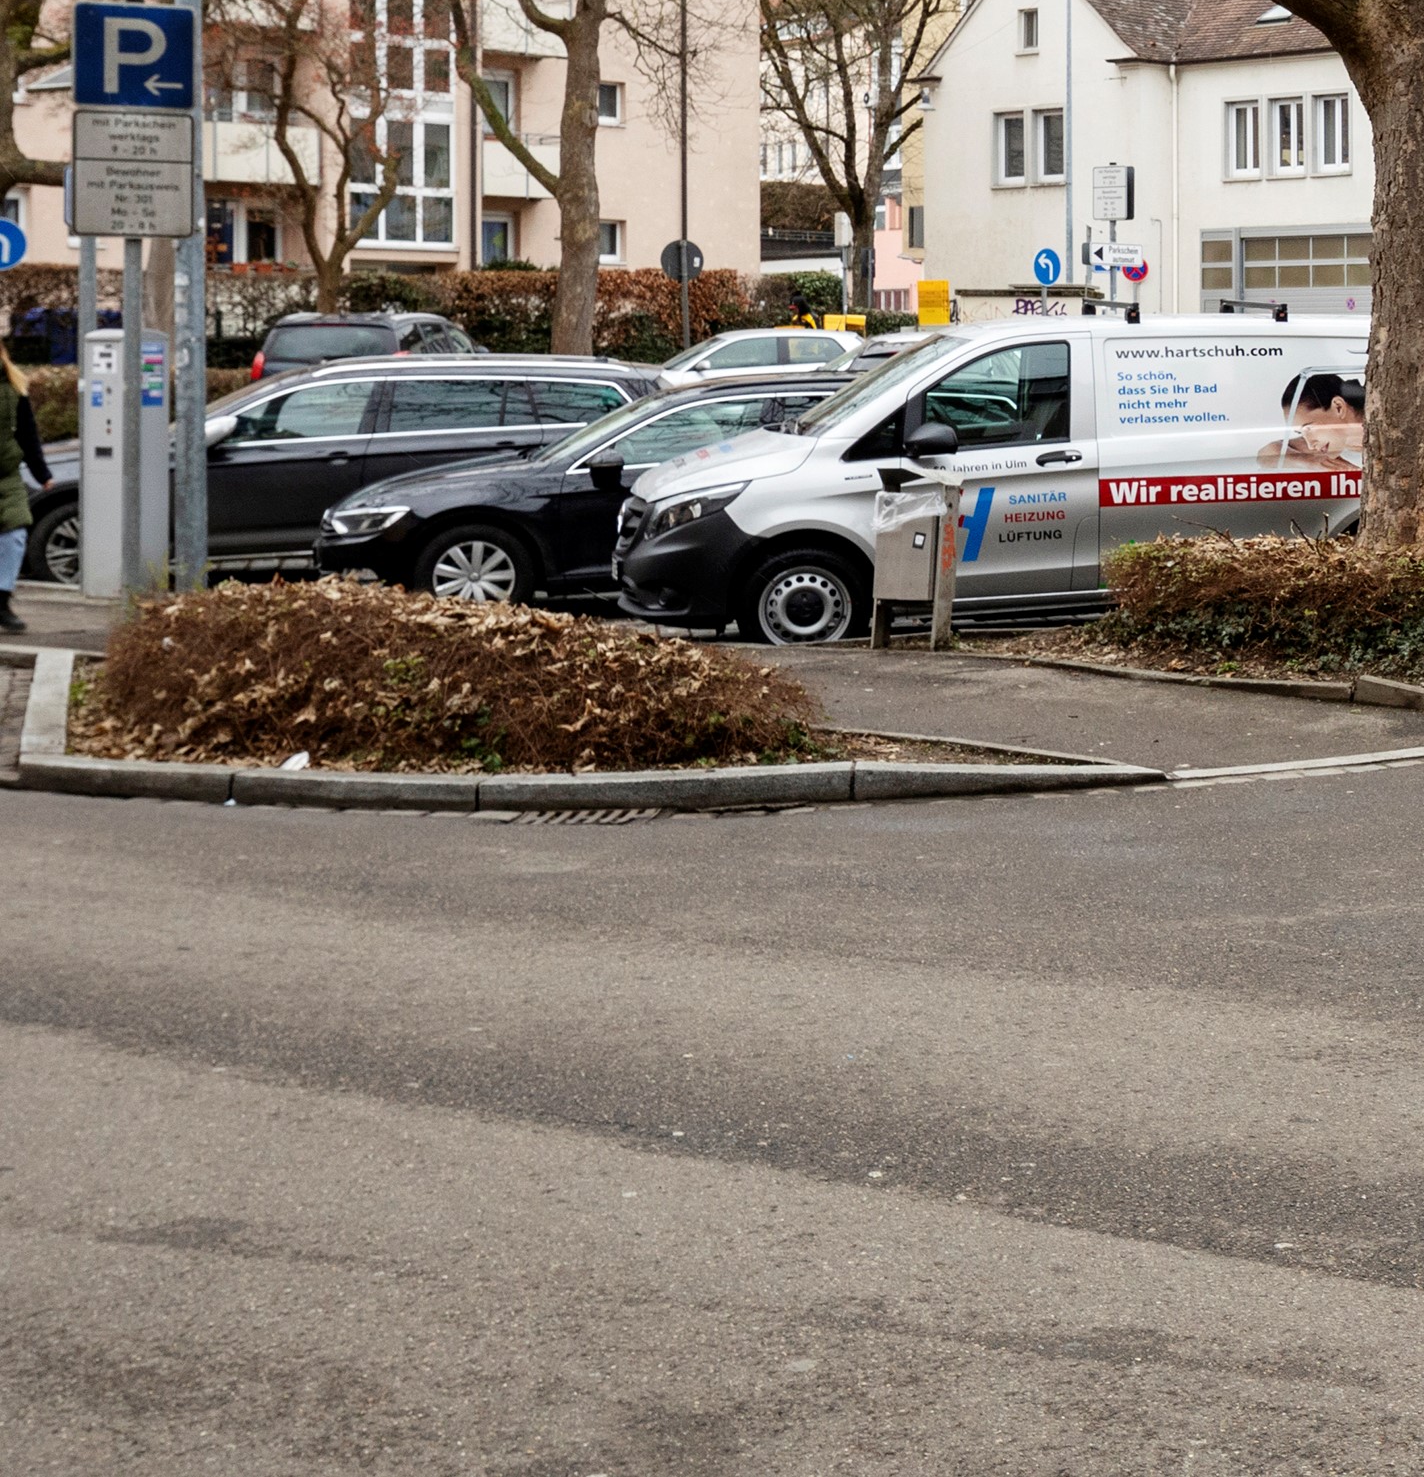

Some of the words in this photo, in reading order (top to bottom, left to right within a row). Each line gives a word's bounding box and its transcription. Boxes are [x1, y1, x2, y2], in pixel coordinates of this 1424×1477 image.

[104, 16, 167, 94] P
[92, 117, 110, 126] mit
[114, 118, 178, 130] Parkschein
[108, 132, 160, 144] werktags
[132, 146, 146, 155] 20
[151, 146, 158, 156] h
[106, 166, 162, 178] Bewohner
[87, 180, 104, 189] mit
[108, 180, 180, 192] Parkausweis
[134, 194, 154, 204] 301
[110, 208, 128, 217] Mo
[110, 220, 124, 230] 20
[1108, 246, 1138, 254] Parkschein
[1112, 256, 1135, 264] automat
[1115, 345, 1284, 360] www.hartschuh.com
[1116, 372, 1132, 382] So
[1136, 370, 1177, 382] schön,
[1118, 385, 1146, 396] dass
[1150, 384, 1169, 395] Sie
[1172, 384, 1190, 394] Ihr
[1194, 383, 1218, 394] Bad
[1118, 399, 1151, 410] nicht
[1154, 398, 1188, 409] mehr
[1119, 414, 1179, 424] verlassen
[1183, 412, 1230, 422] wollen.
[992, 462, 1002, 470] in
[1005, 459, 1028, 470] Ulm
[1108, 480, 1162, 504] Wir
[1170, 476, 1322, 502] realisieren
[1008, 491, 1067, 505] SANITÄR
[1004, 510, 1066, 524] HEIZUNG
[998, 529, 1062, 543] LÜFTUNG
